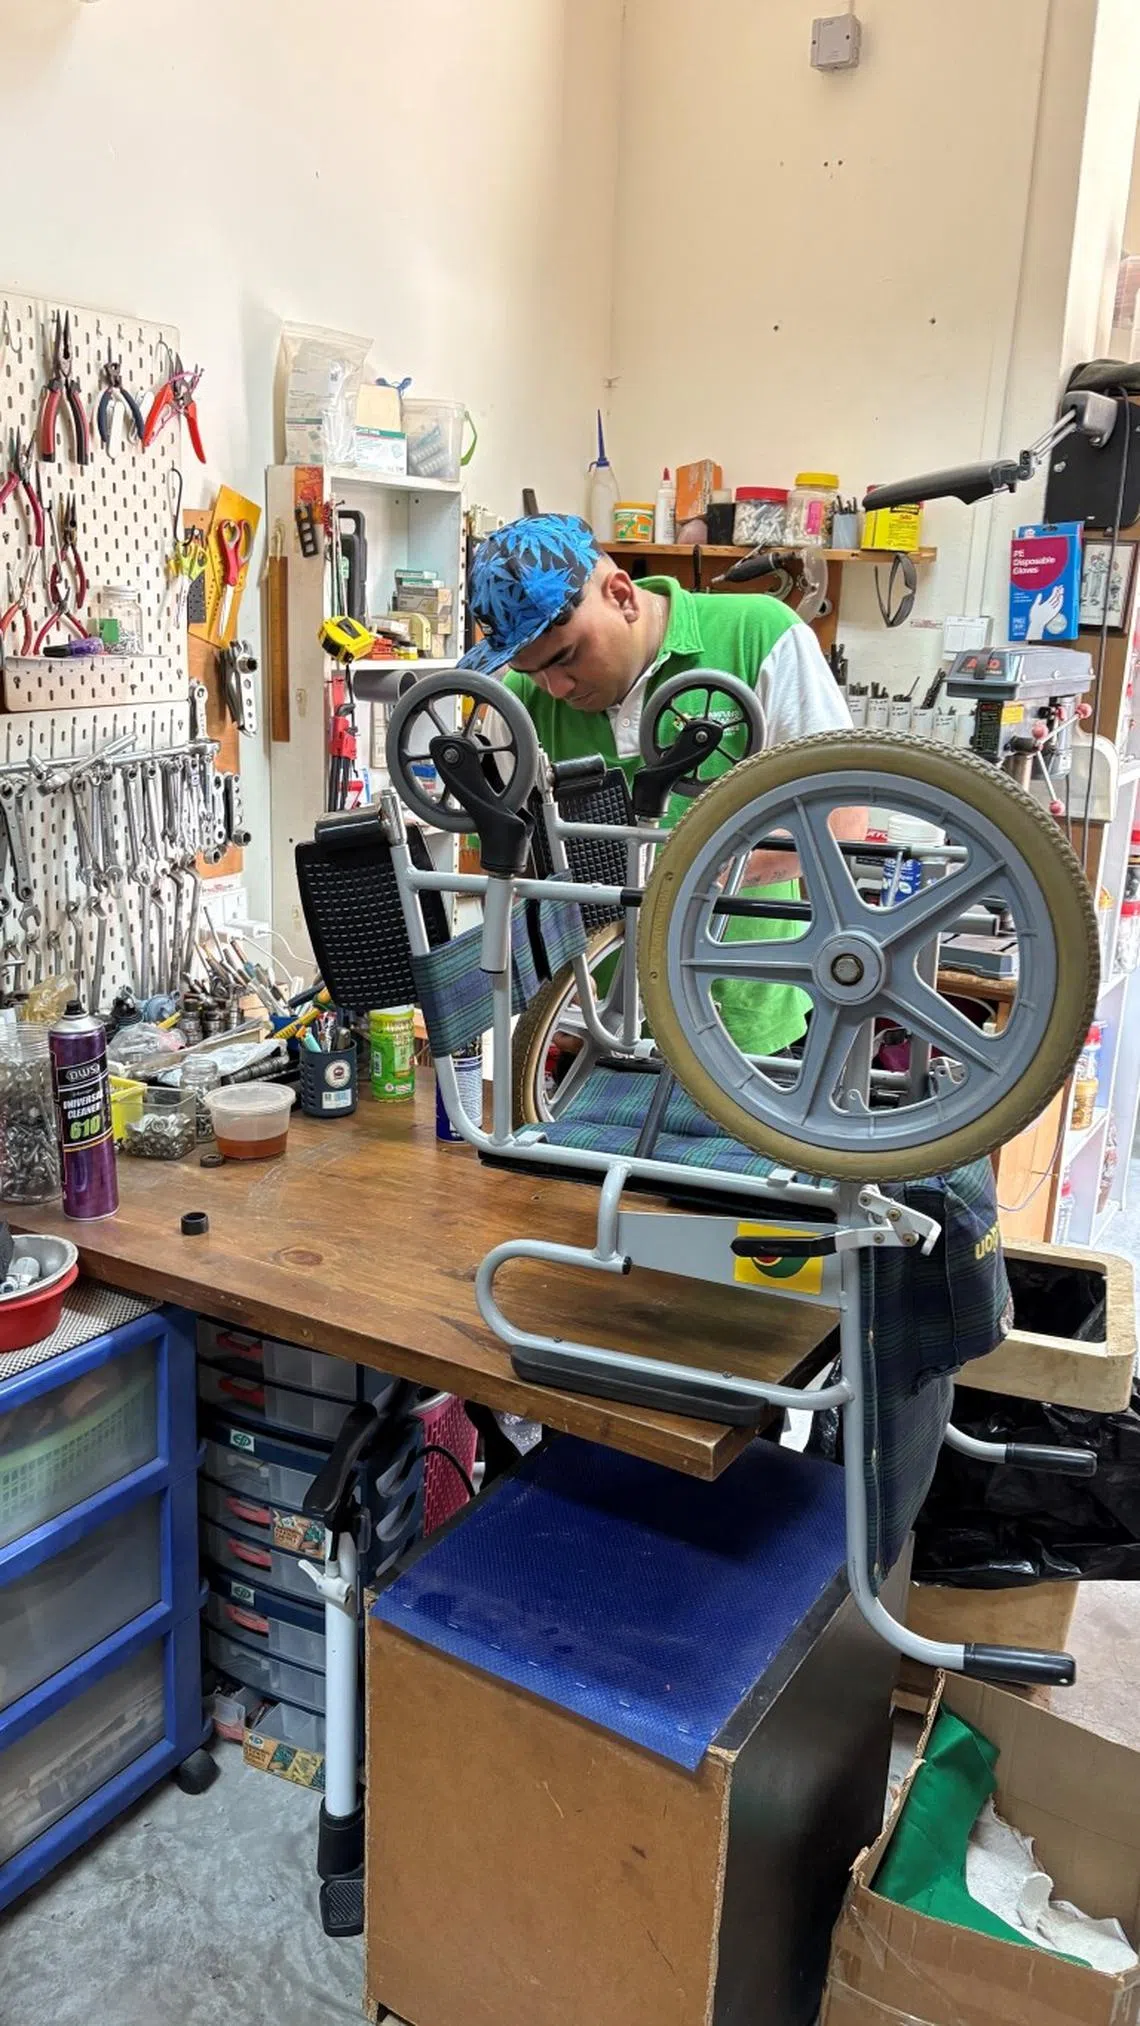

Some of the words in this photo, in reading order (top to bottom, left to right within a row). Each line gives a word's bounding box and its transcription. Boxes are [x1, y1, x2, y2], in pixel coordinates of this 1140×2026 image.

[1013, 549, 1025, 557] PE
[1013, 557, 1056, 567] Disposable
[1013, 567, 1039, 575] Gloves
[70, 1115, 101, 1139] 610
